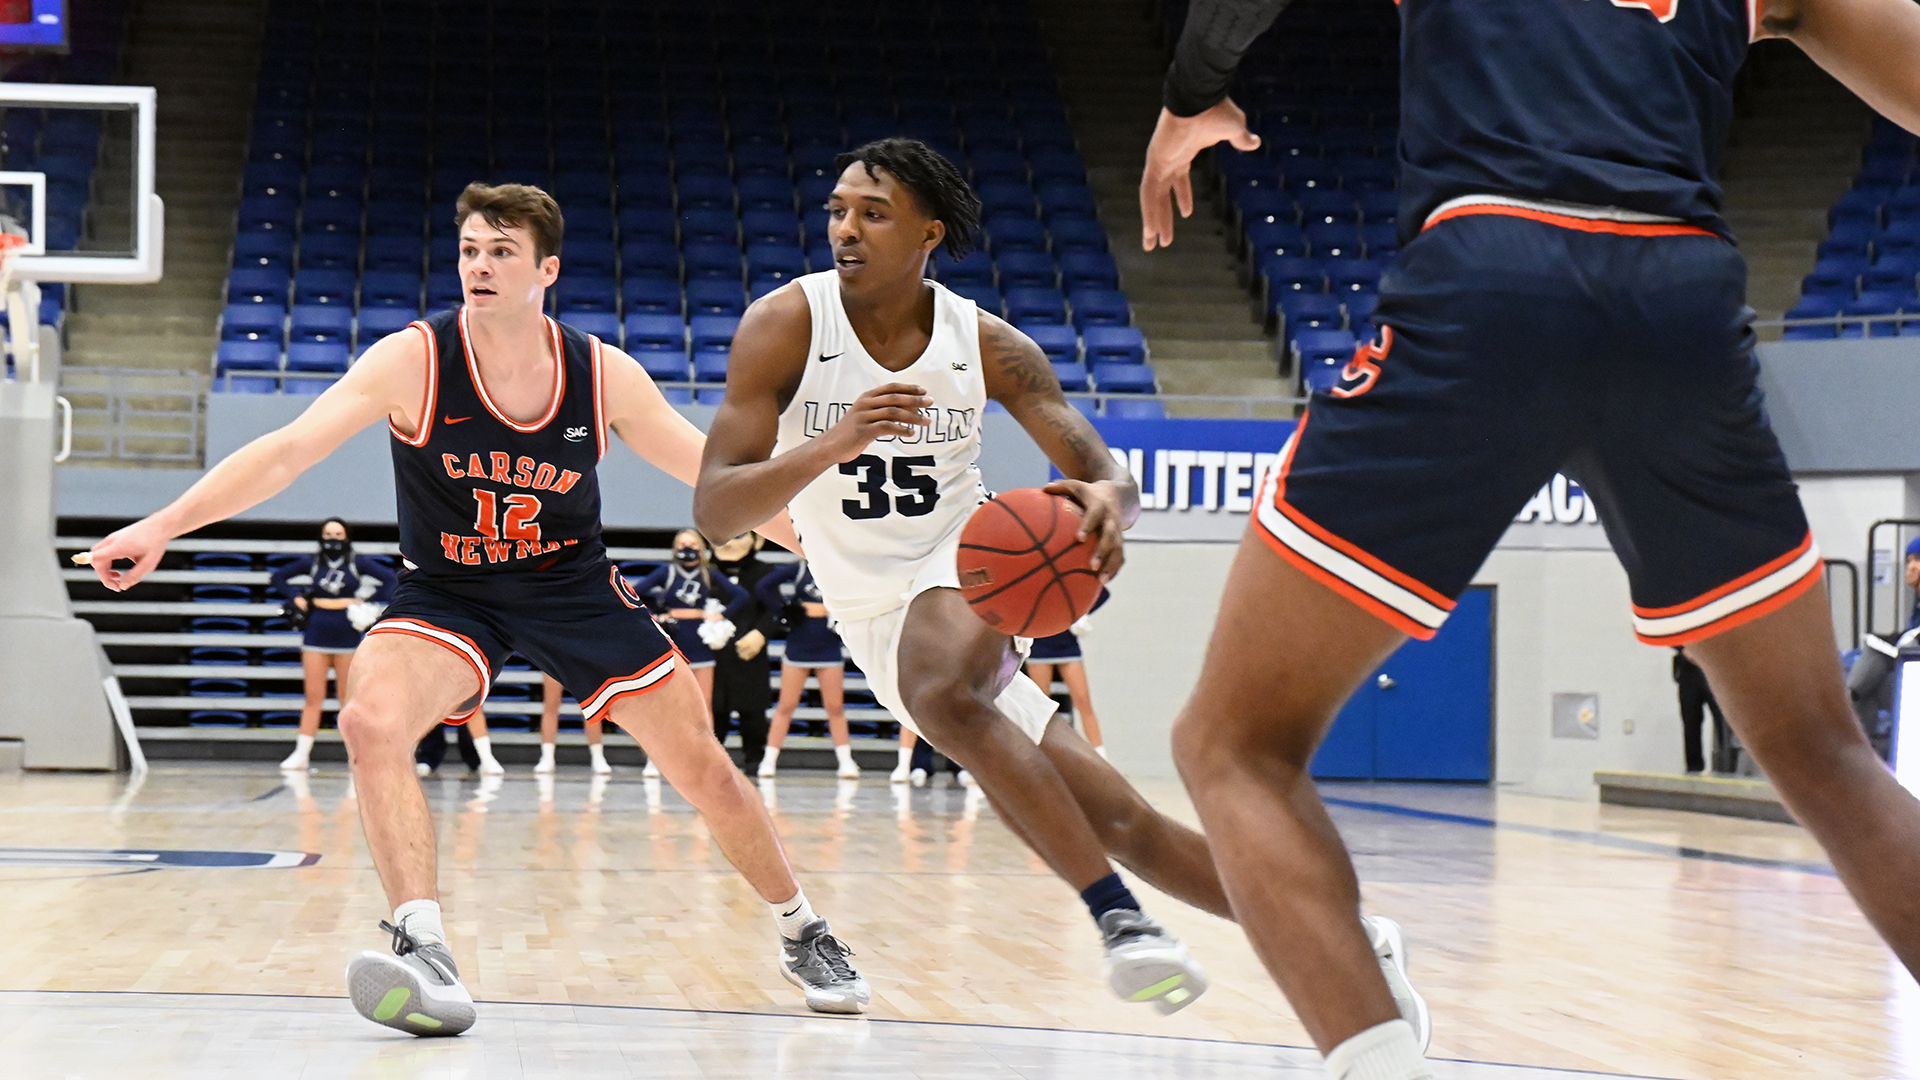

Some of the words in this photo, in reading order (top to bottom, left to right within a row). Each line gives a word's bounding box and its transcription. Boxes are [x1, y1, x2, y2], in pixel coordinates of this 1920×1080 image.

[951, 362, 968, 371] SAC
[566, 426, 588, 438] SAC
[804, 401, 975, 445] LIOLN
[441, 451, 582, 494] CARSON
[838, 453, 941, 520] 35
[1108, 448, 1279, 511] LITTE
[472, 488, 542, 540] 12
[440, 531, 579, 565] NEWMA
